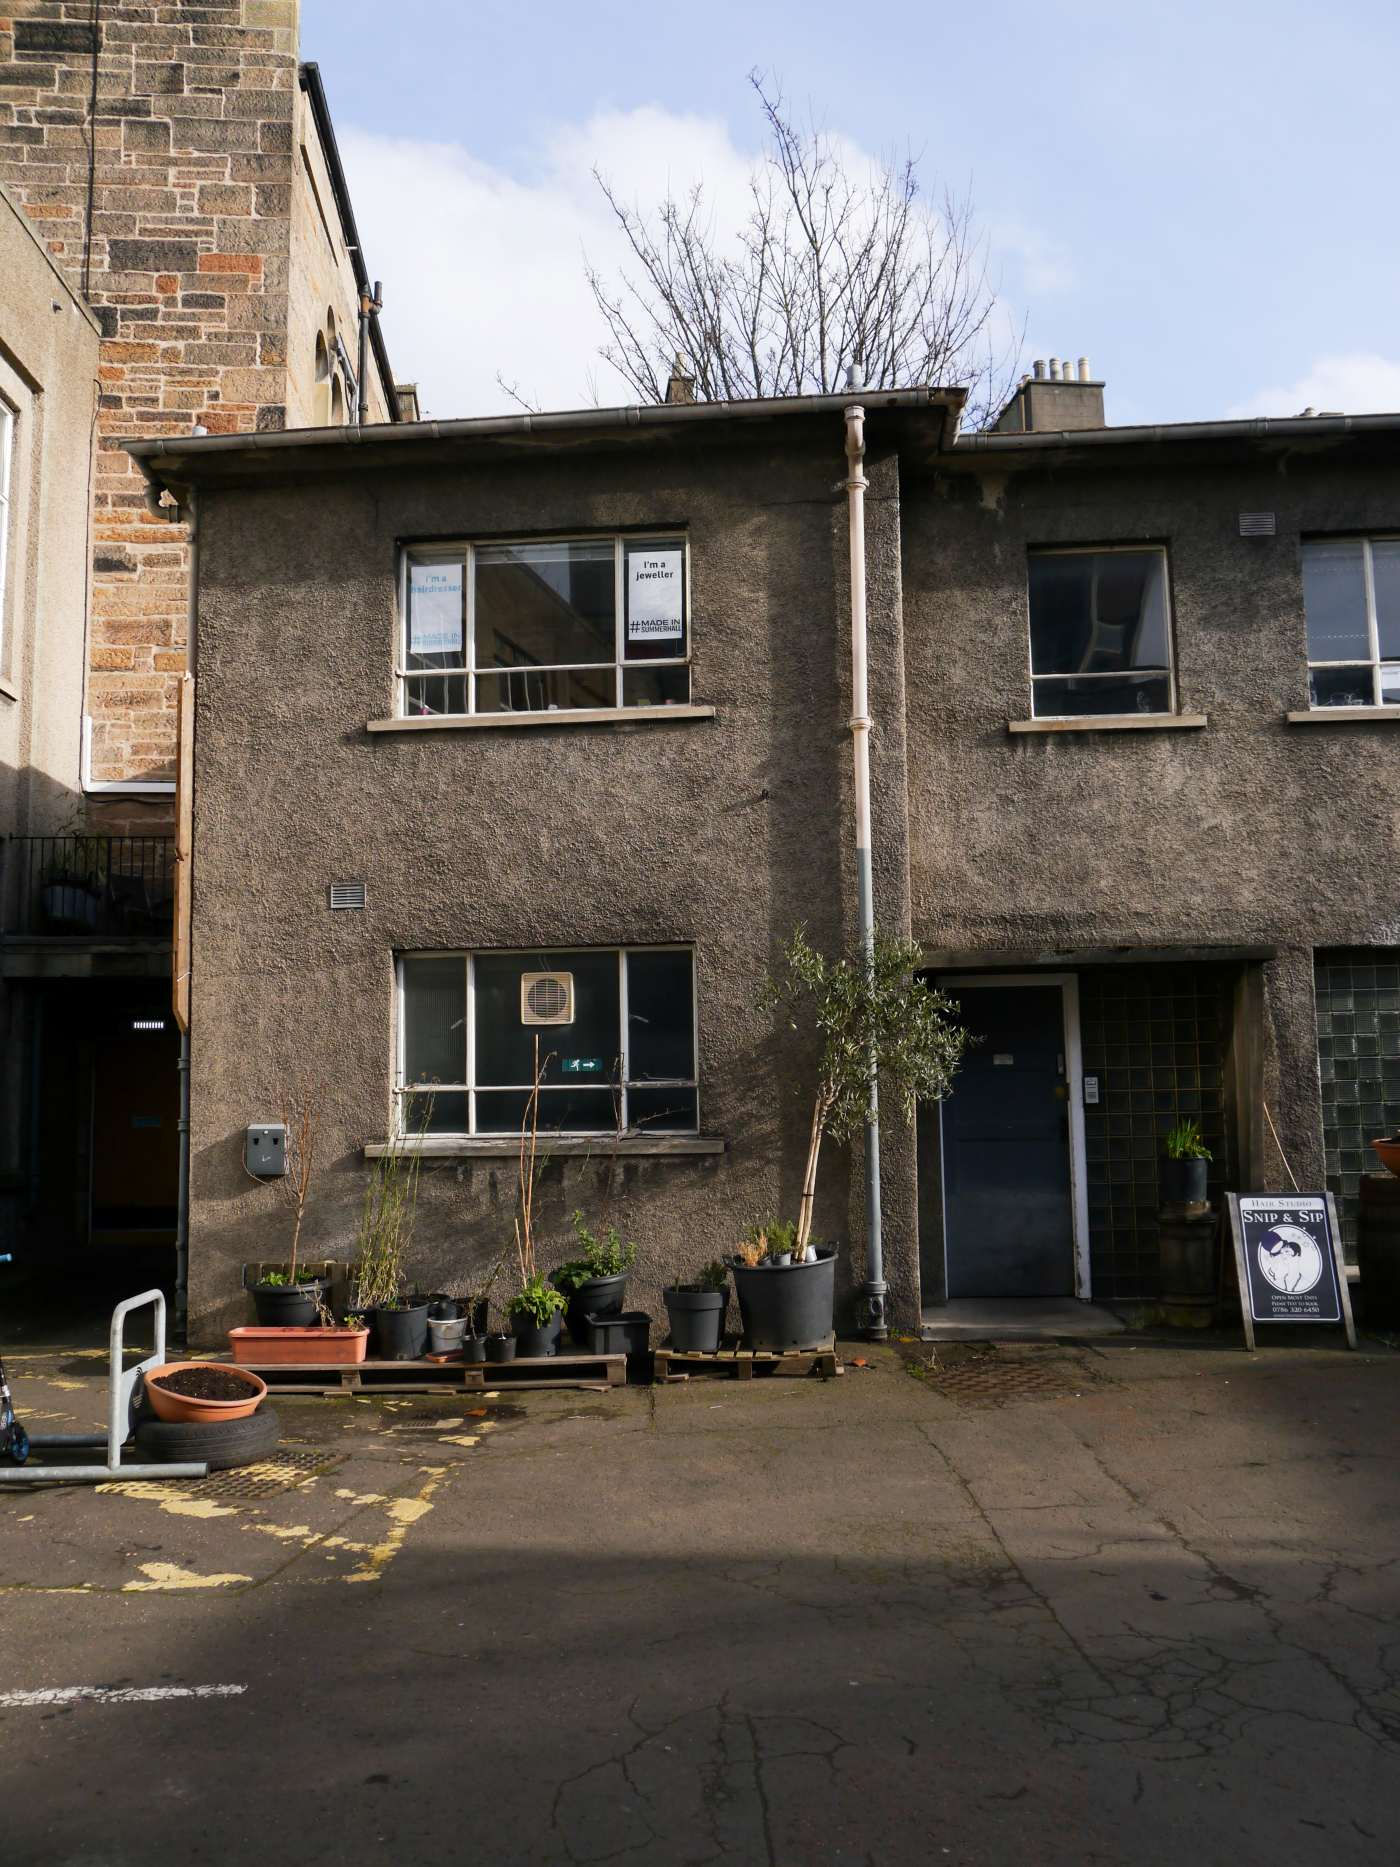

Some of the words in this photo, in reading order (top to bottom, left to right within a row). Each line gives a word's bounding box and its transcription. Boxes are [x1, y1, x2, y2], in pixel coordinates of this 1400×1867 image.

[644, 561, 658, 569] I'm
[636, 571, 673, 582] jeweller
[1243, 1210, 1278, 1223] SNIP
[1282, 1213, 1294, 1223] &
[1298, 1210, 1323, 1223] SIP
